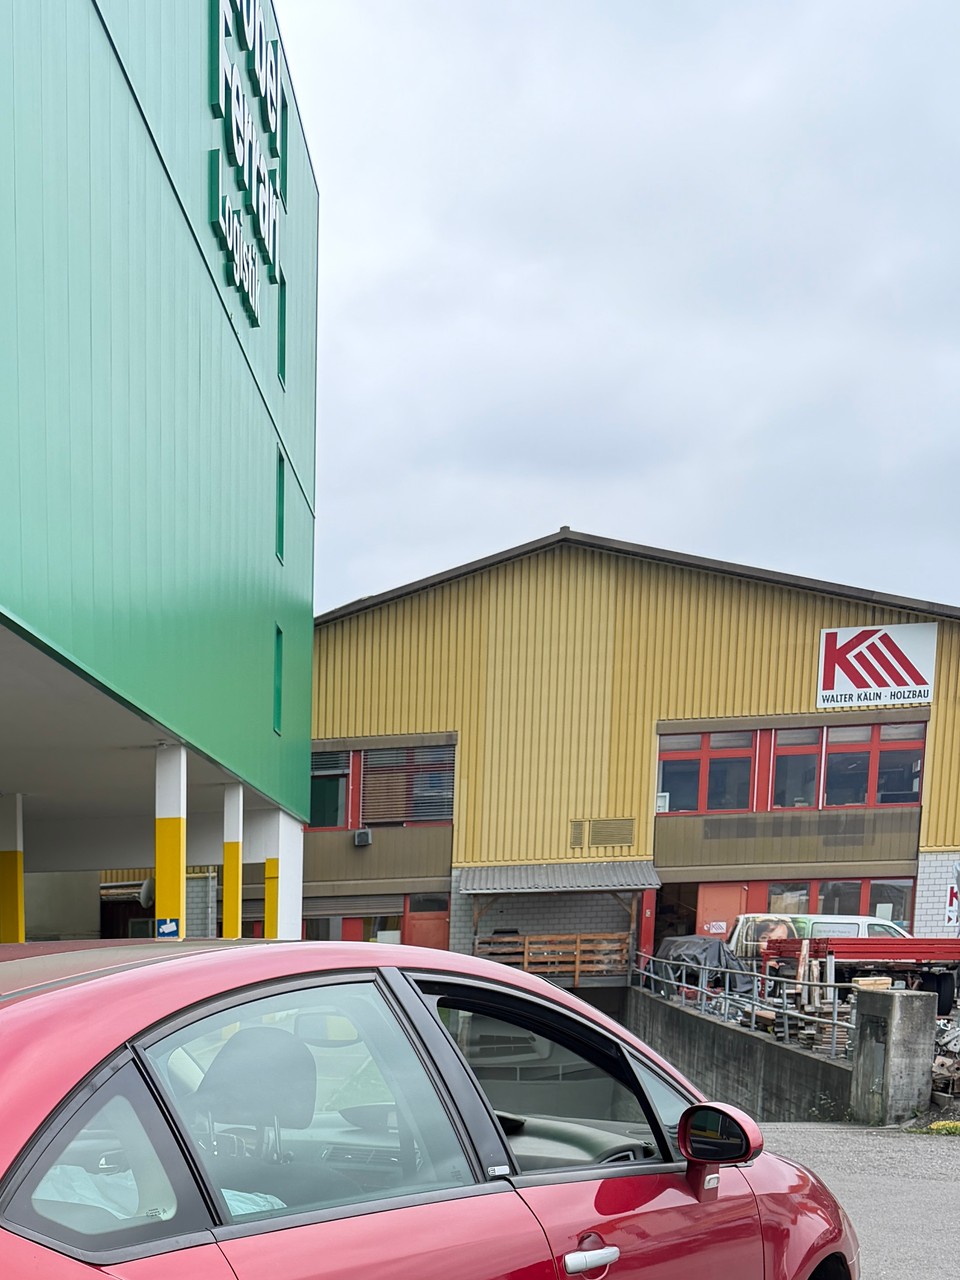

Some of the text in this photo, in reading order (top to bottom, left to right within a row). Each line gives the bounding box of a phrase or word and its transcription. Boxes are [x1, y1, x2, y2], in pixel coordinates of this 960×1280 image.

[218, 0, 280, 284] Ferrari
[218, 148, 261, 326] Logistik
[822, 689, 930, 704] WALTER KÄLIN HOLZBAU
